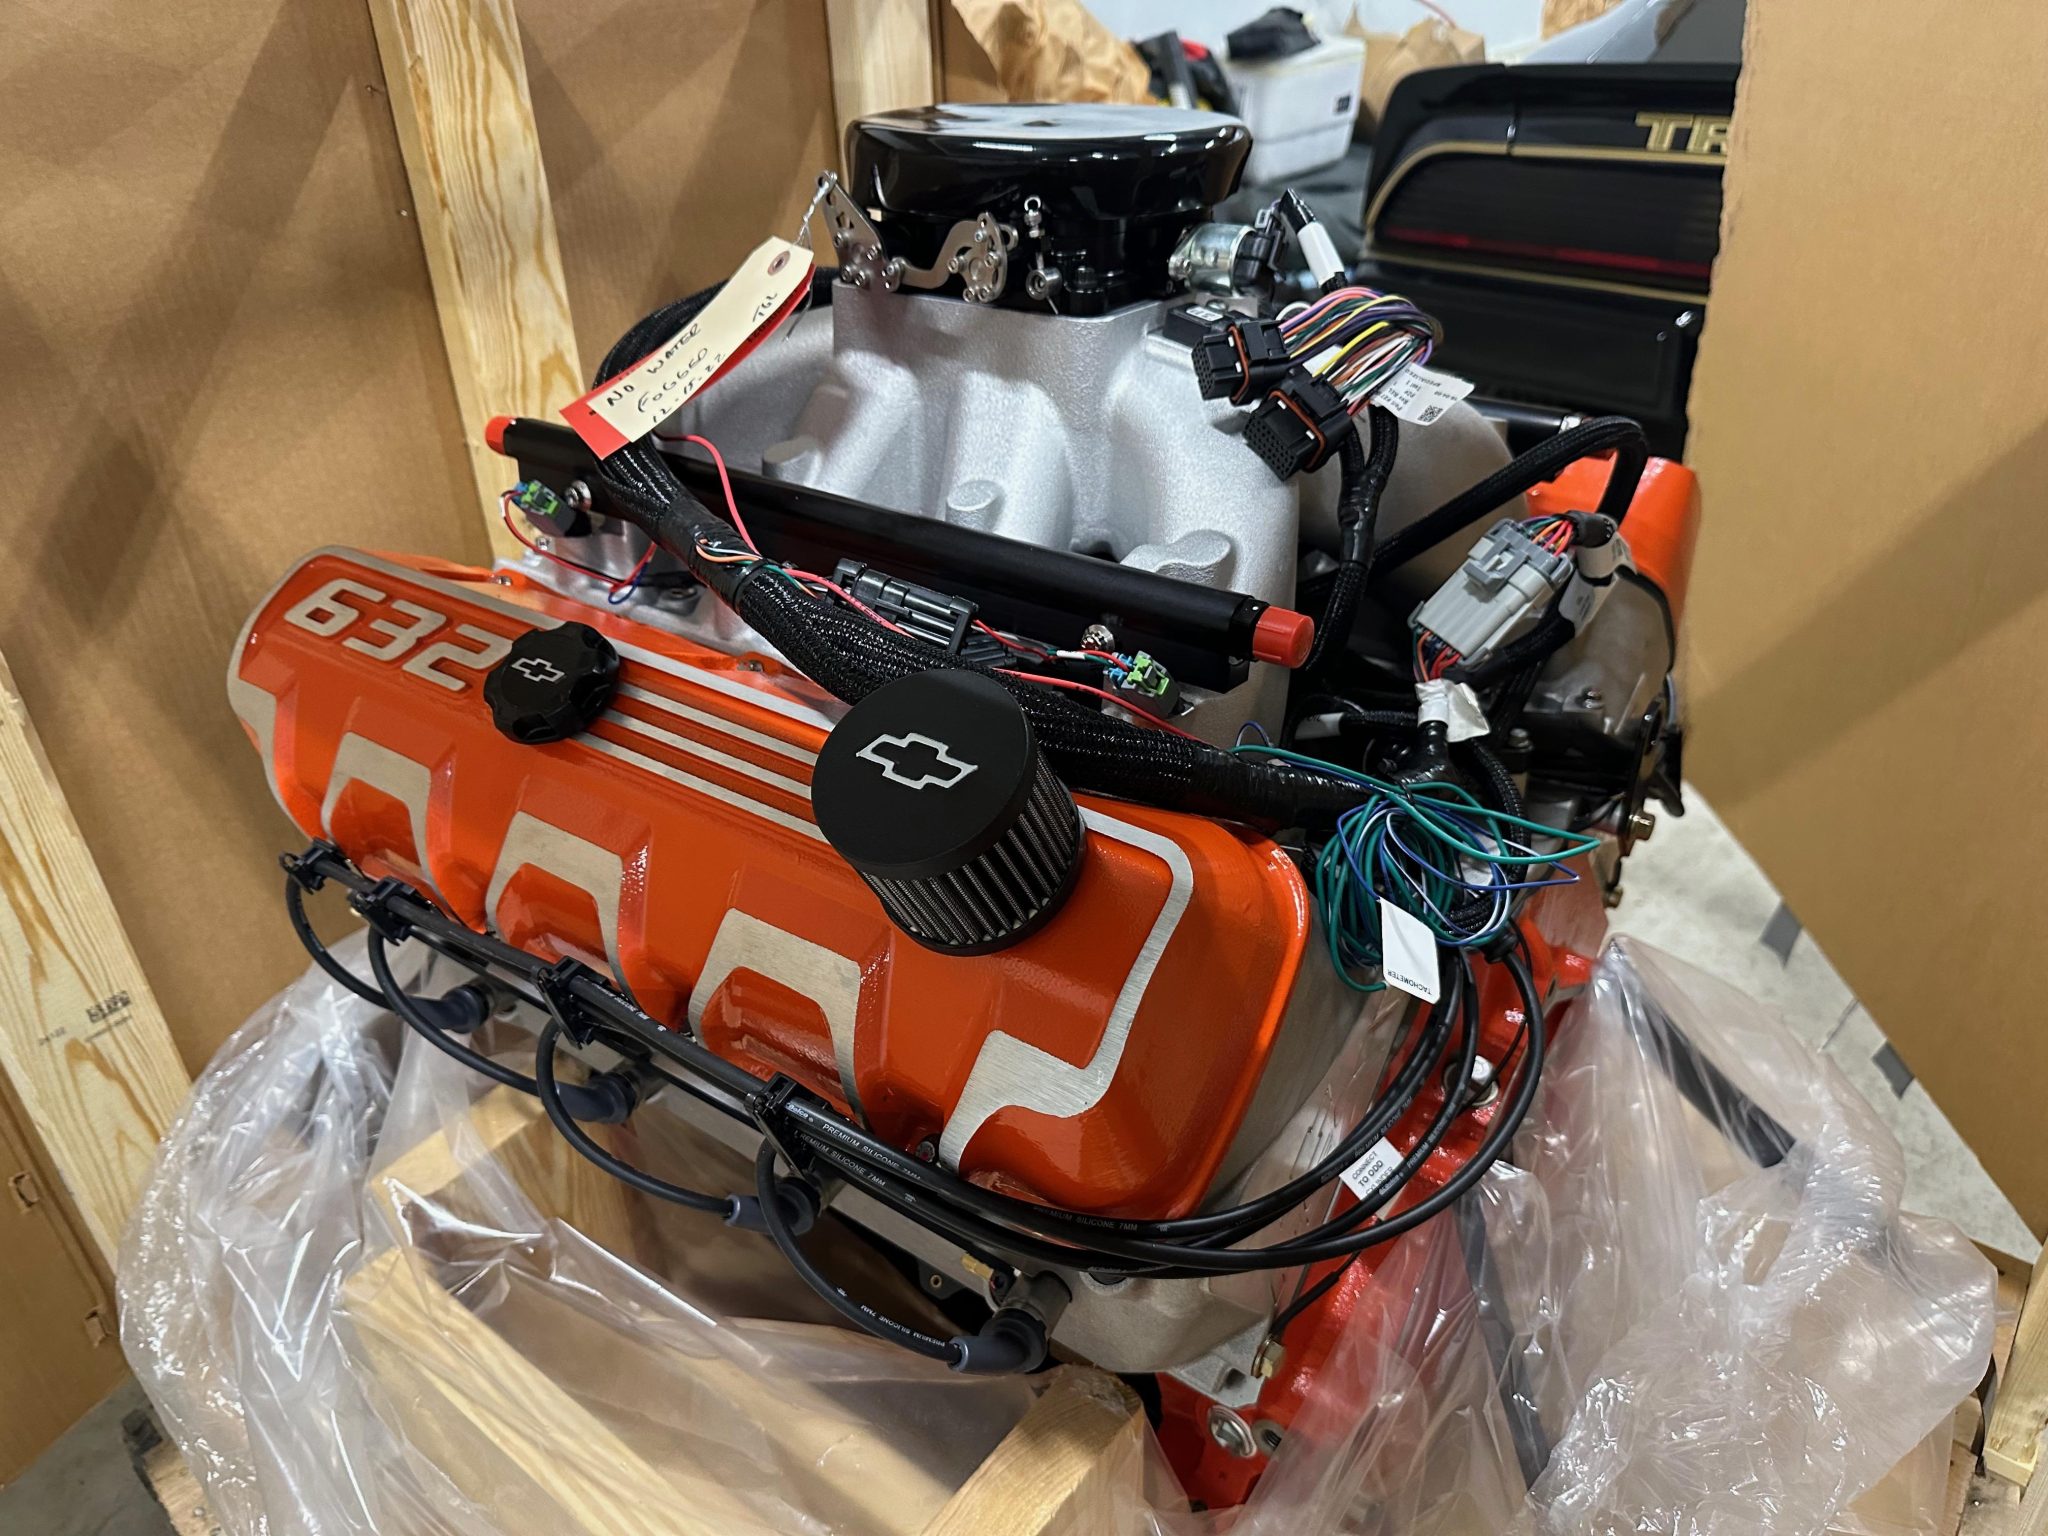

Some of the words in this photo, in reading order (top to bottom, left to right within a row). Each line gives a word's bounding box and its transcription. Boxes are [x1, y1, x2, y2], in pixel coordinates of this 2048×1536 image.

[606, 384, 635, 406] NO
[646, 323, 701, 374] WATER
[283, 578, 512, 692] 632
[1387, 969, 1432, 995] TACHOMETER
[822, 1123, 860, 1147] PREMIUM
[862, 1145, 900, 1169] SILICONE
[830, 1150, 866, 1175] SILICONE
[868, 1172, 886, 1186] 7MM
[1352, 1150, 1377, 1180] CONNECT
[1358, 1175, 1369, 1187] TO
[1368, 1159, 1384, 1177] ODD
[1077, 1215, 1115, 1229] SILICONE
[1119, 1222, 1138, 1232] 7MM
[879, 1315, 911, 1335] SILICONE
